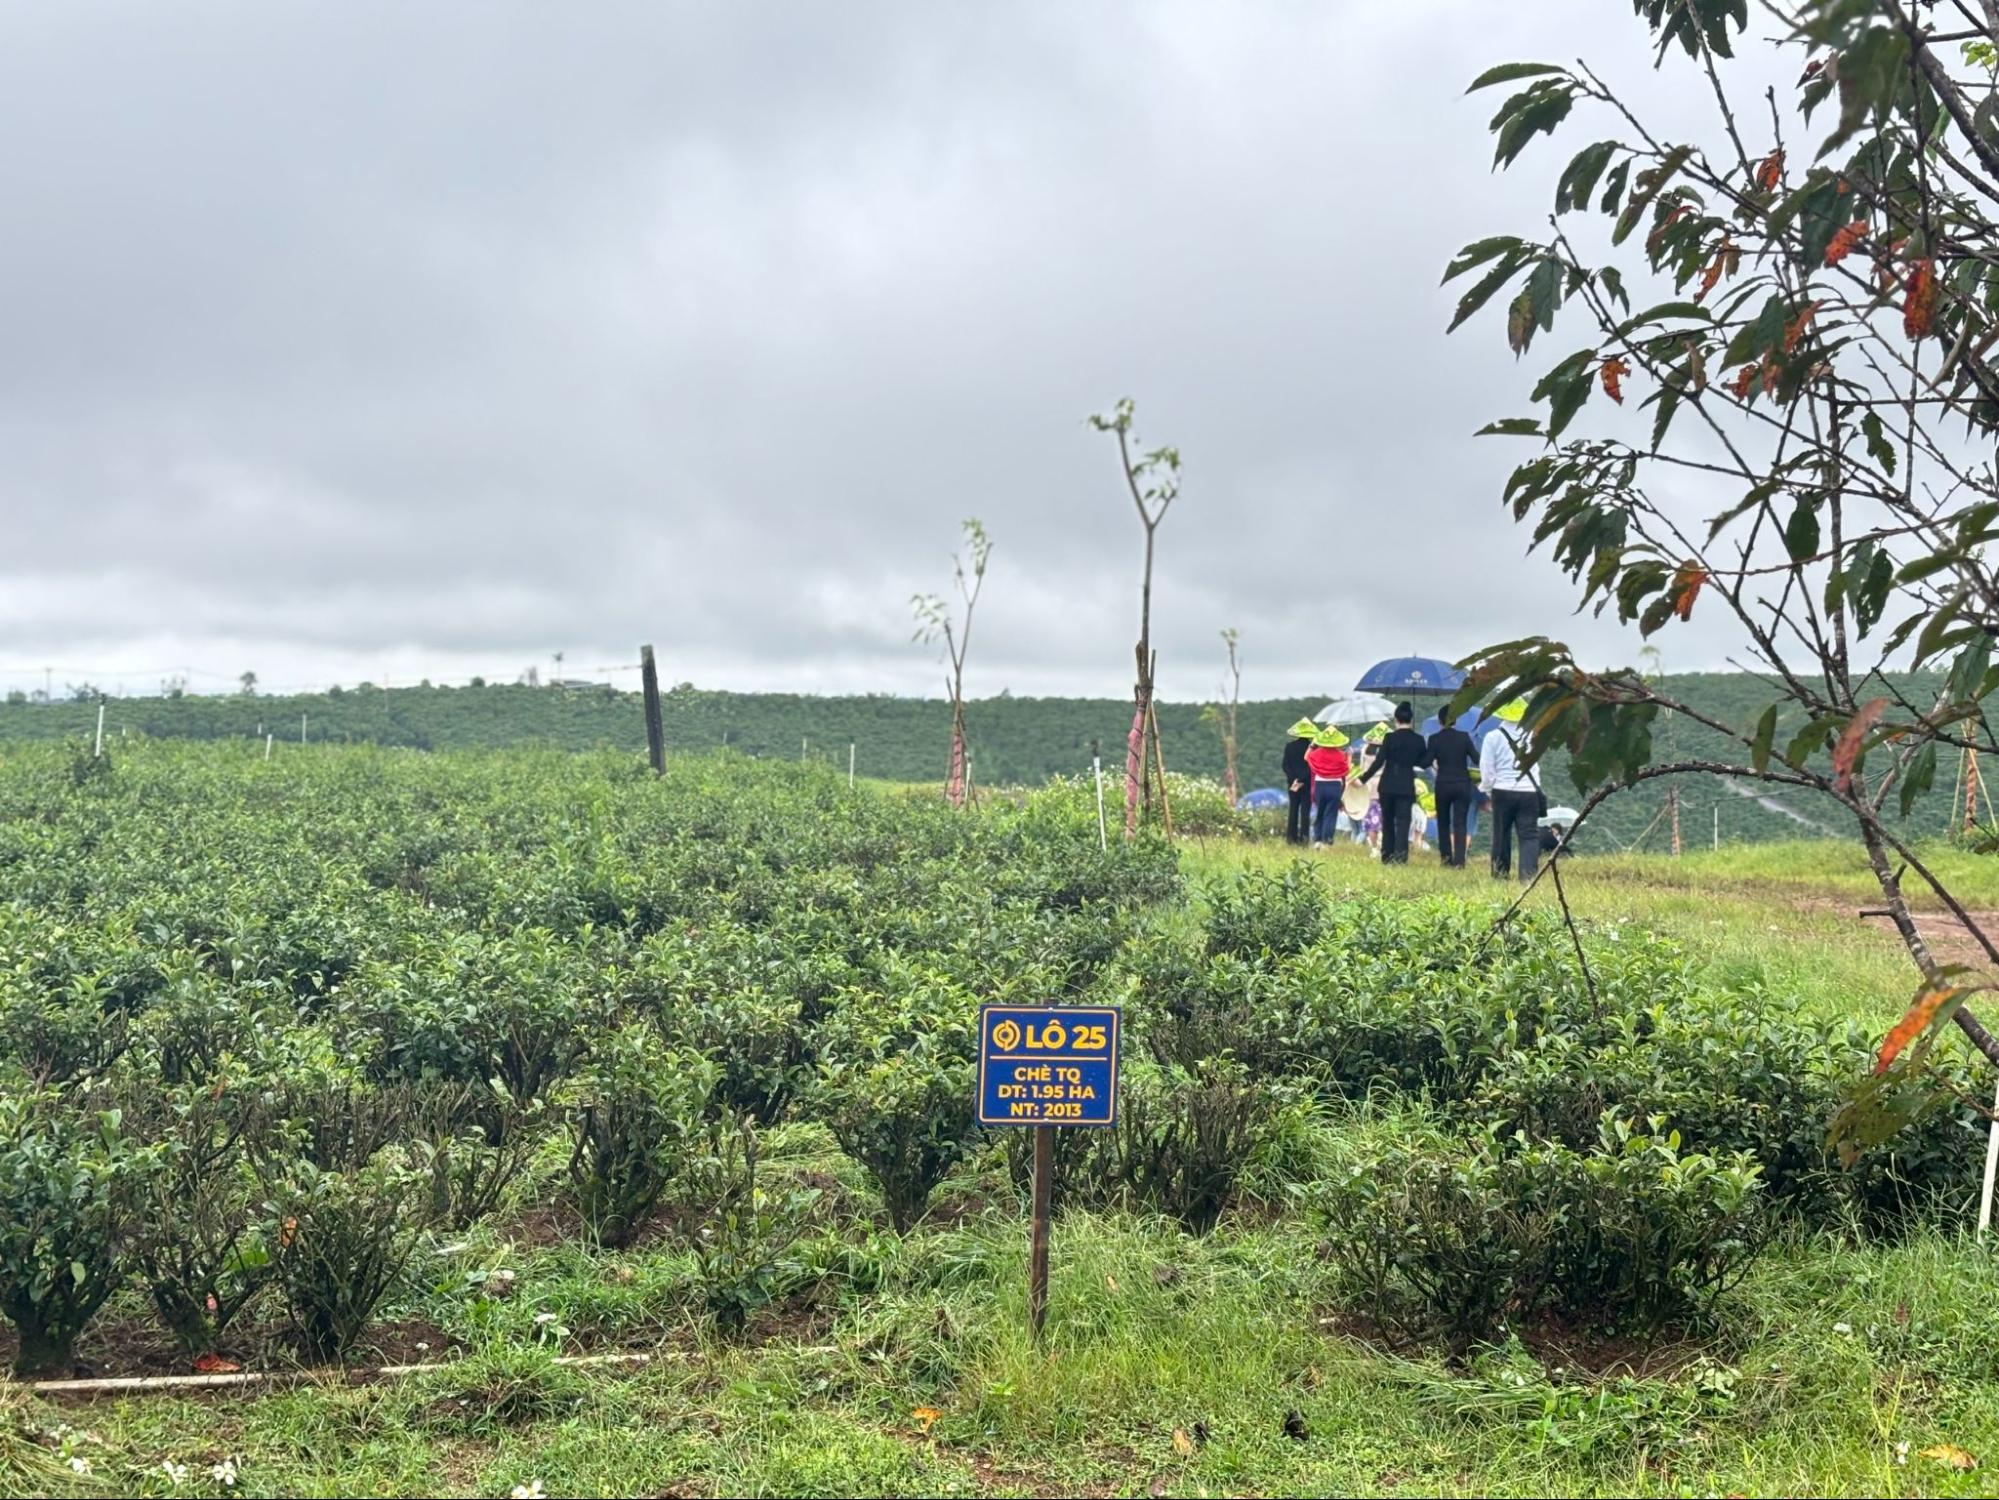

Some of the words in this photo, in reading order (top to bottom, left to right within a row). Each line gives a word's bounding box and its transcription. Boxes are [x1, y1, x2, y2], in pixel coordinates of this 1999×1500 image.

[1026, 1019, 1067, 1049] LÔ
[1072, 1025, 1106, 1049] 25
[1014, 1064, 1051, 1081] CHÈ
[1056, 1067, 1081, 1084] TQ
[998, 1084, 1027, 1098] DT:
[1031, 1085, 1064, 1099] 1.95
[1069, 1086, 1095, 1099] HA
[1010, 1102, 1039, 1116] NT:
[1043, 1103, 1082, 1117] 2013
